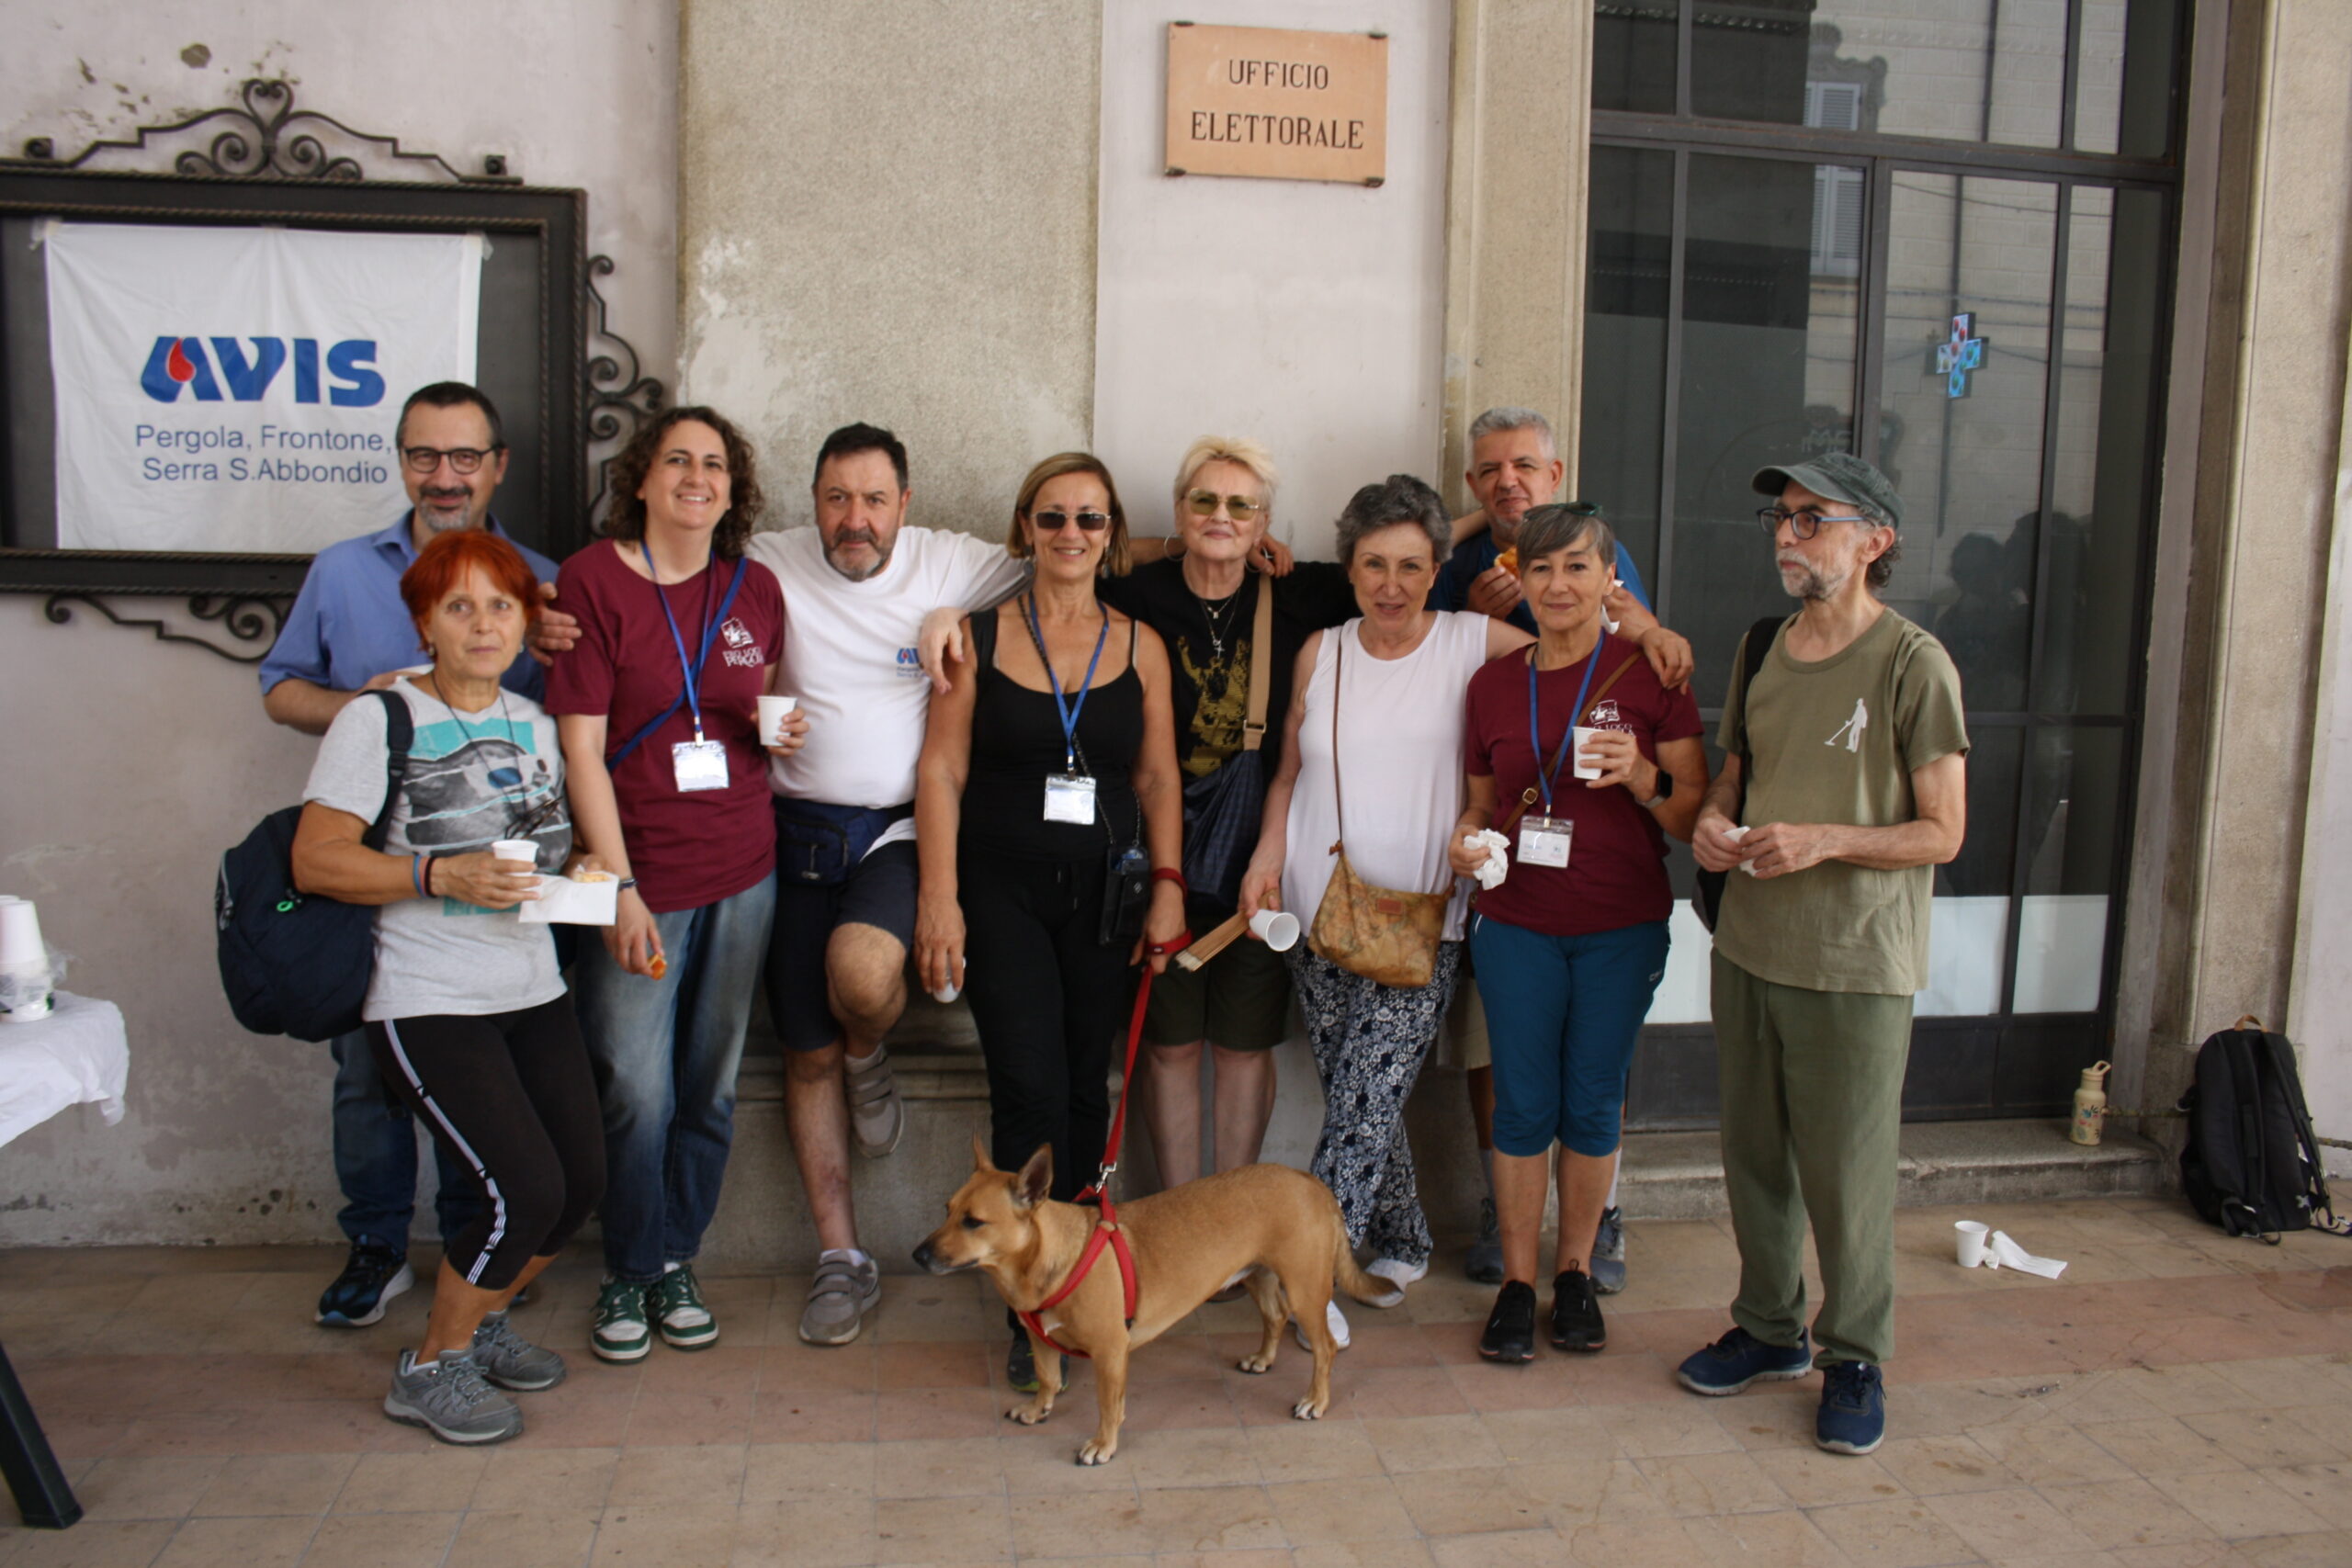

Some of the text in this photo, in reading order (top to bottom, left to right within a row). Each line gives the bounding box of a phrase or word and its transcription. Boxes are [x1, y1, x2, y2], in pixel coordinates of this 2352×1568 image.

[1228, 59, 1329, 90] UFFICIO
[1191, 110, 1364, 150] ELETTORALE
[141, 336, 386, 407] AVIS
[135, 424, 392, 455] Pergola, Frontone,
[142, 457, 388, 484] Serra S.Abbondio
